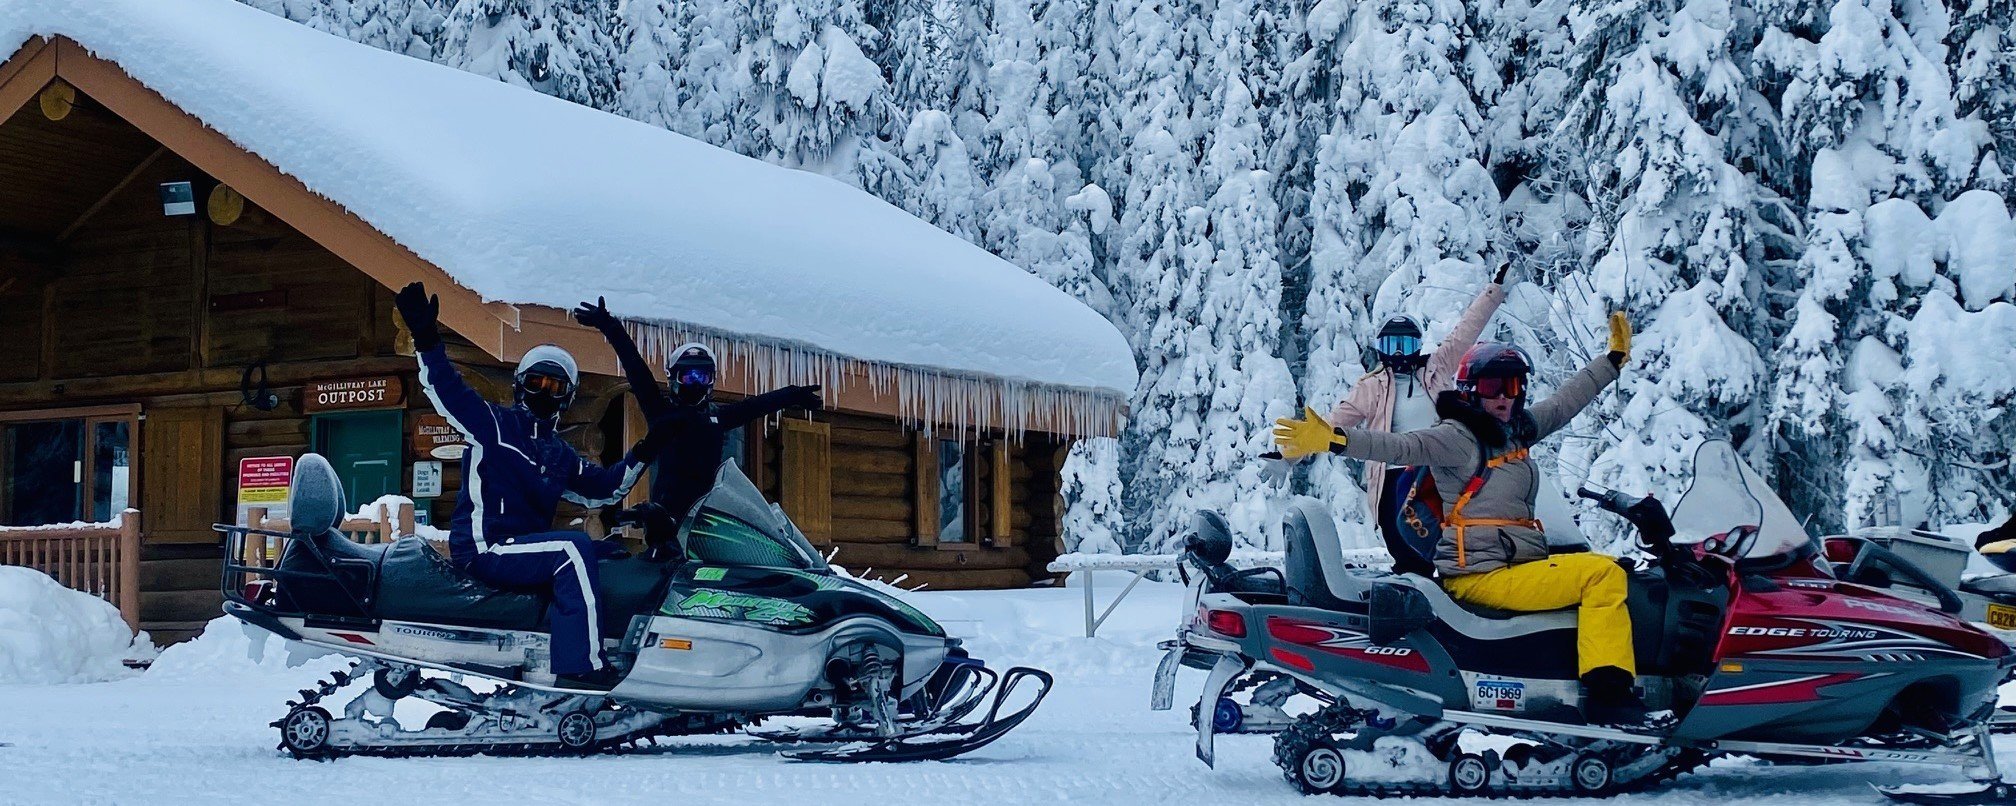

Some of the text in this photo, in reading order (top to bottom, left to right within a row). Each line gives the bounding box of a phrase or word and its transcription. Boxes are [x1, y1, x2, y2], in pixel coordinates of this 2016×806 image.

[317, 379, 387, 391] McGILLIVRAY LAKE
[318, 389, 385, 404] OUTPOST
[1728, 626, 1877, 639] EDGE TOURING
[1364, 646, 1411, 656] 600
[1478, 686, 1522, 700] 6C1969
